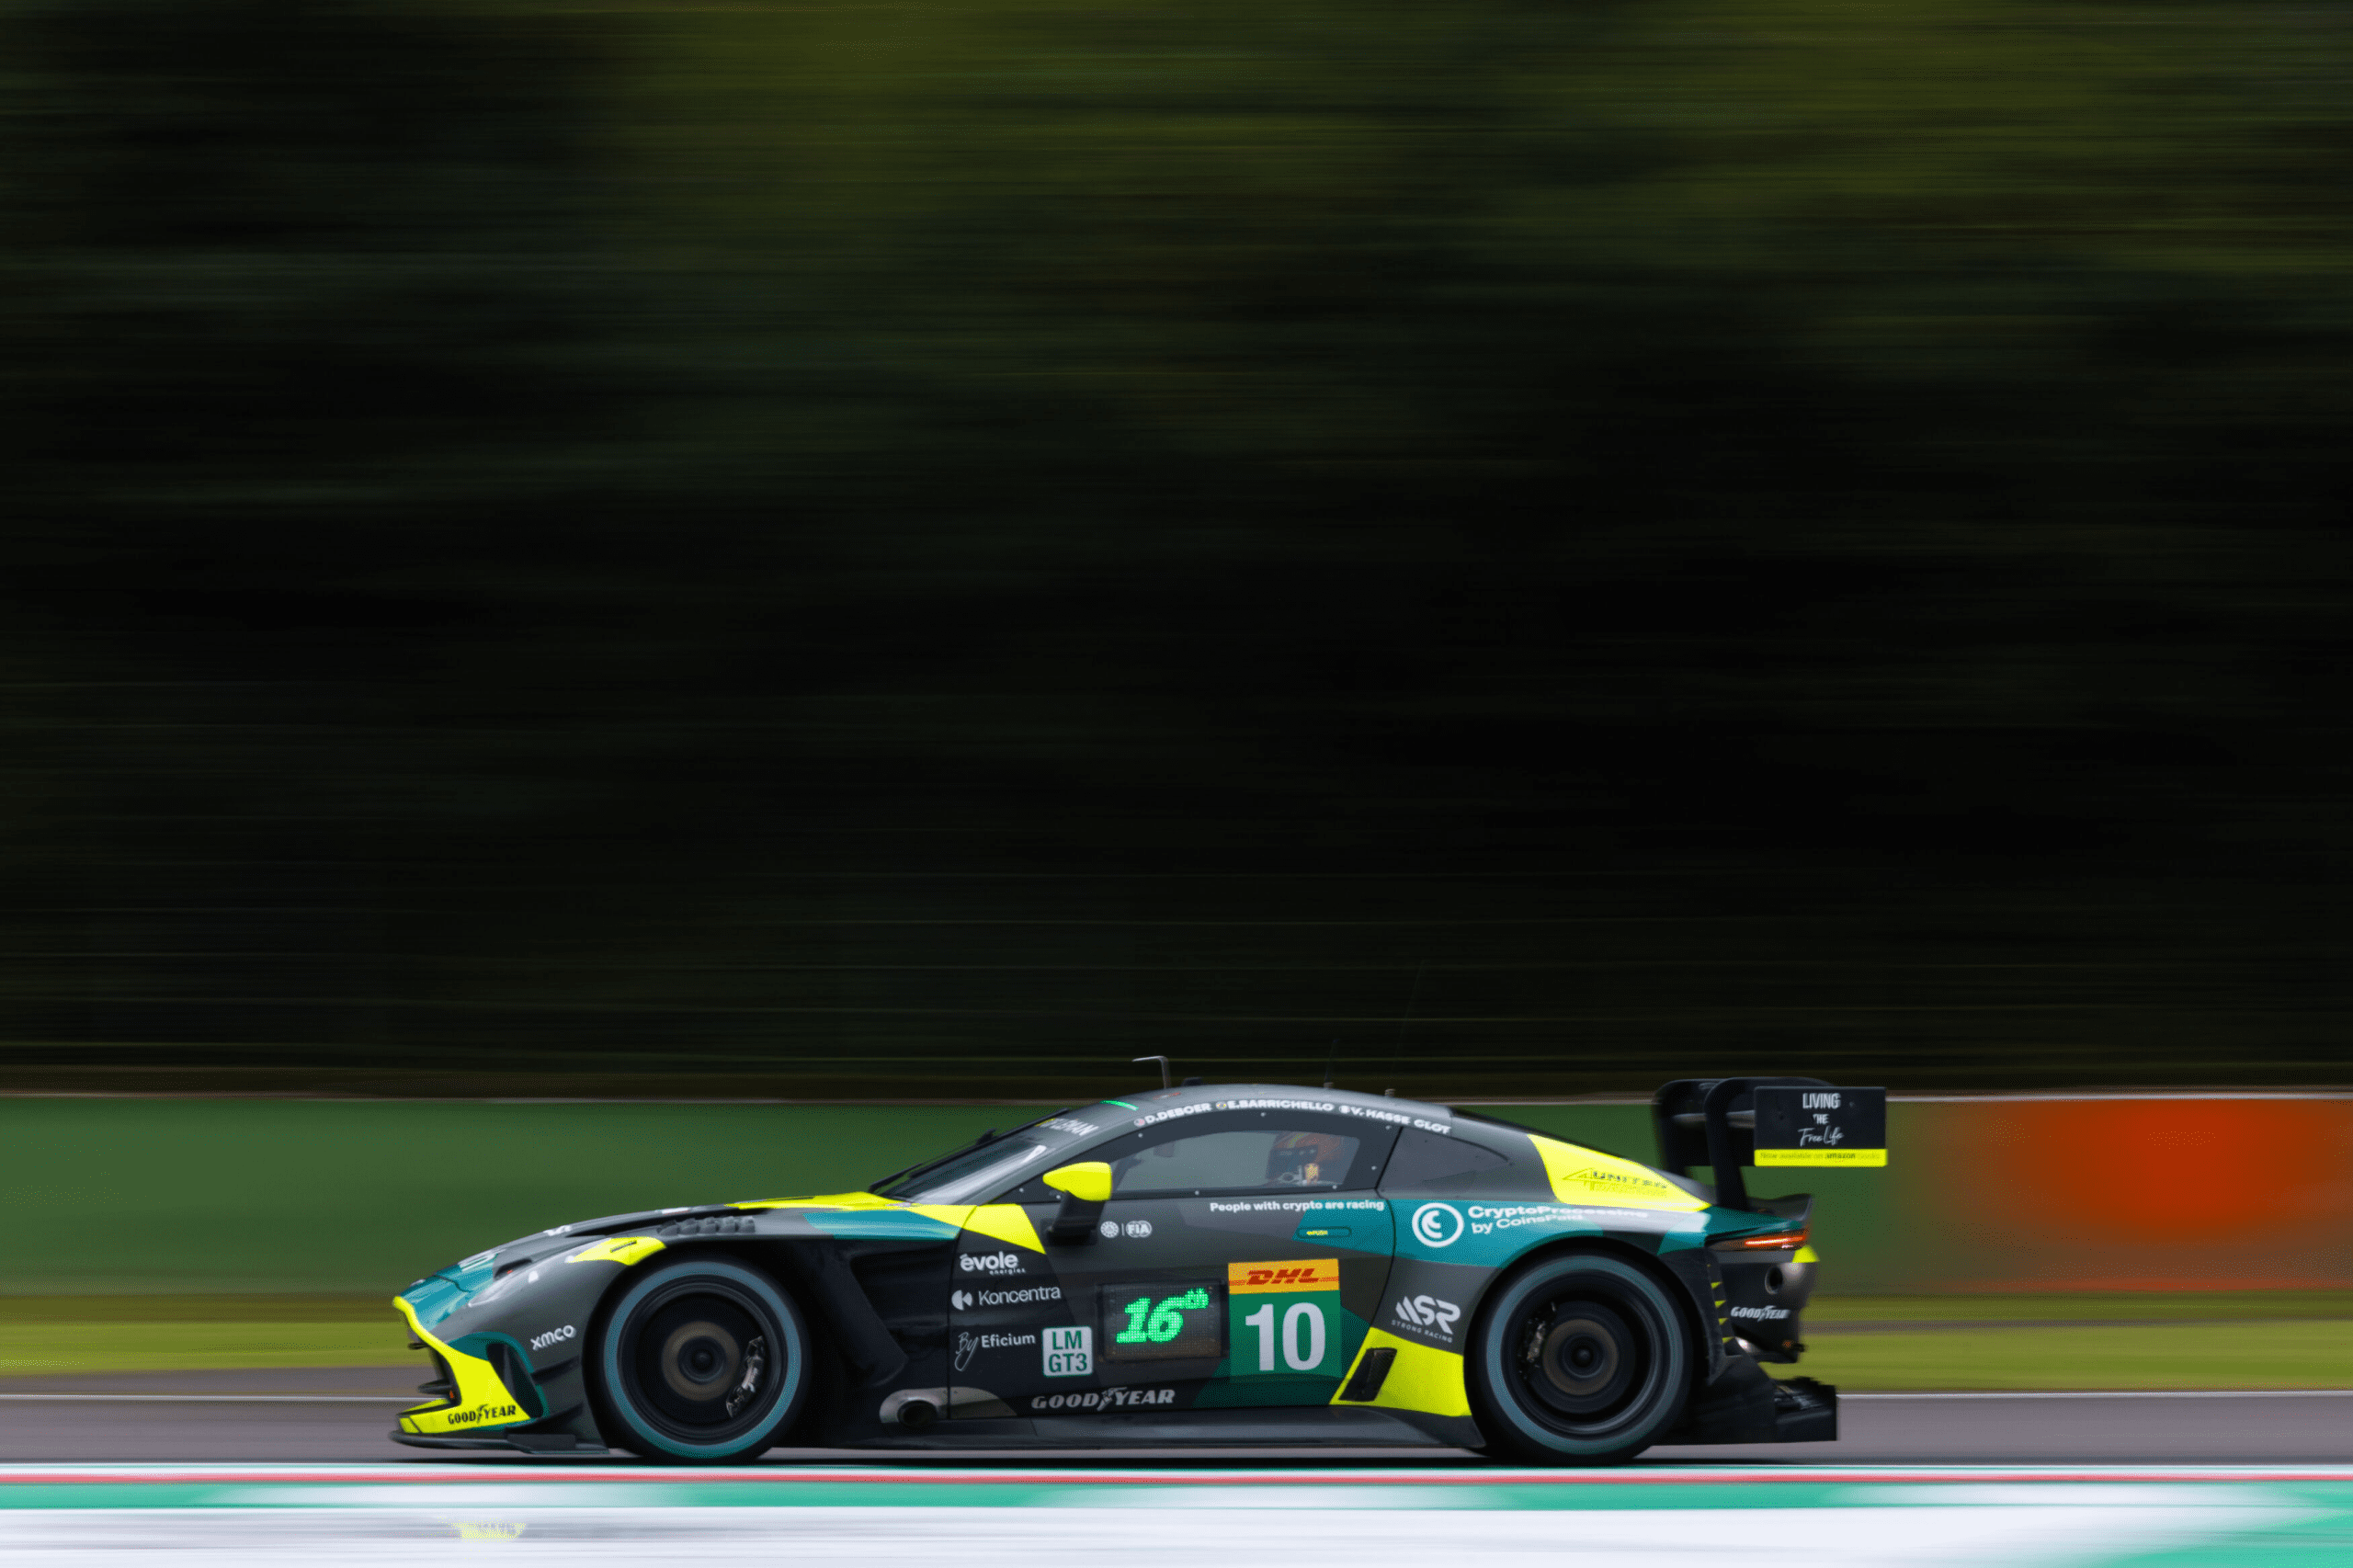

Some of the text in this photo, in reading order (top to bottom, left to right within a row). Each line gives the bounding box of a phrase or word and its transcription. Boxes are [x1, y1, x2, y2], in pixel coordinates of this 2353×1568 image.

[1802, 1093, 1841, 1109] LIVING
[1813, 1113, 1830, 1124] THE
[1210, 1199, 1385, 1213] People with crypto are racing
[1128, 1224, 1149, 1234] FIA
[1472, 1222, 1493, 1234] by
[1246, 1268, 1319, 1285] DHL
[979, 1286, 1062, 1306] Koncentra
[1730, 1305, 1790, 1322] GOODYEAR
[981, 1334, 1036, 1348] Eficium
[1052, 1330, 1082, 1350] LM
[1245, 1302, 1325, 1370] 10
[1049, 1353, 1087, 1372] GT3
[1031, 1387, 1176, 1411] GOODYEAR
[448, 1404, 517, 1425] GOODYEAR
